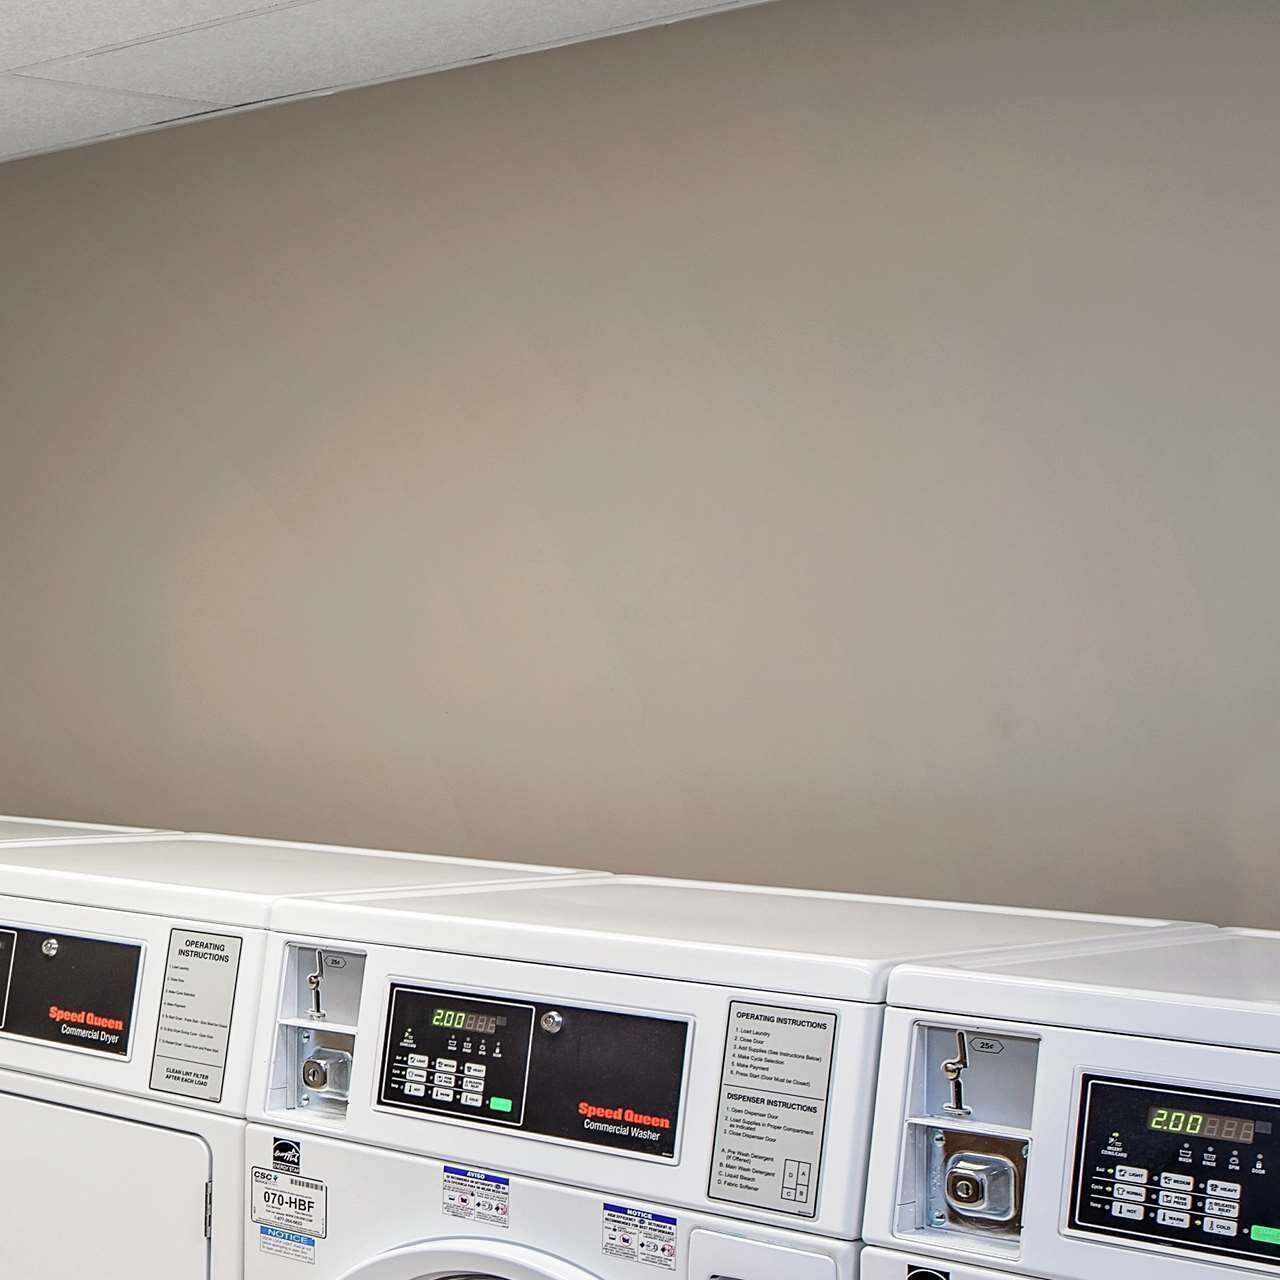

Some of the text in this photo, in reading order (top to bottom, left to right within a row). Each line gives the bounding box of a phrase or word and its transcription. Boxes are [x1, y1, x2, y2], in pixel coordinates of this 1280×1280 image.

[185, 939, 225, 951] OPERATING
[178, 949, 229, 963] INSTRUCTIONS
[49, 1006, 124, 1030] Speed Queen
[736, 1011, 827, 1030] OPERATING INSTRUCTIONS
[61, 1024, 119, 1044] Commercial Dryer
[165, 1074, 180, 1082] AFTER
[181, 1076, 193, 1084] EACH
[166, 1067, 209, 1080] CLEAN LINT FILTER
[727, 1093, 817, 1113] DISPENSER INSTRUCTIONS
[578, 1102, 670, 1129] Speed Queen
[1151, 1110, 1203, 1134] 2.00
[584, 1119, 661, 1141] Commercial Washer
[254, 1171, 272, 1181] CSC
[466, 1171, 486, 1179] AVISO
[264, 1191, 315, 1212] 070-HBF
[627, 1209, 652, 1219] NOTICE
[268, 1229, 309, 1244] NOTICE
